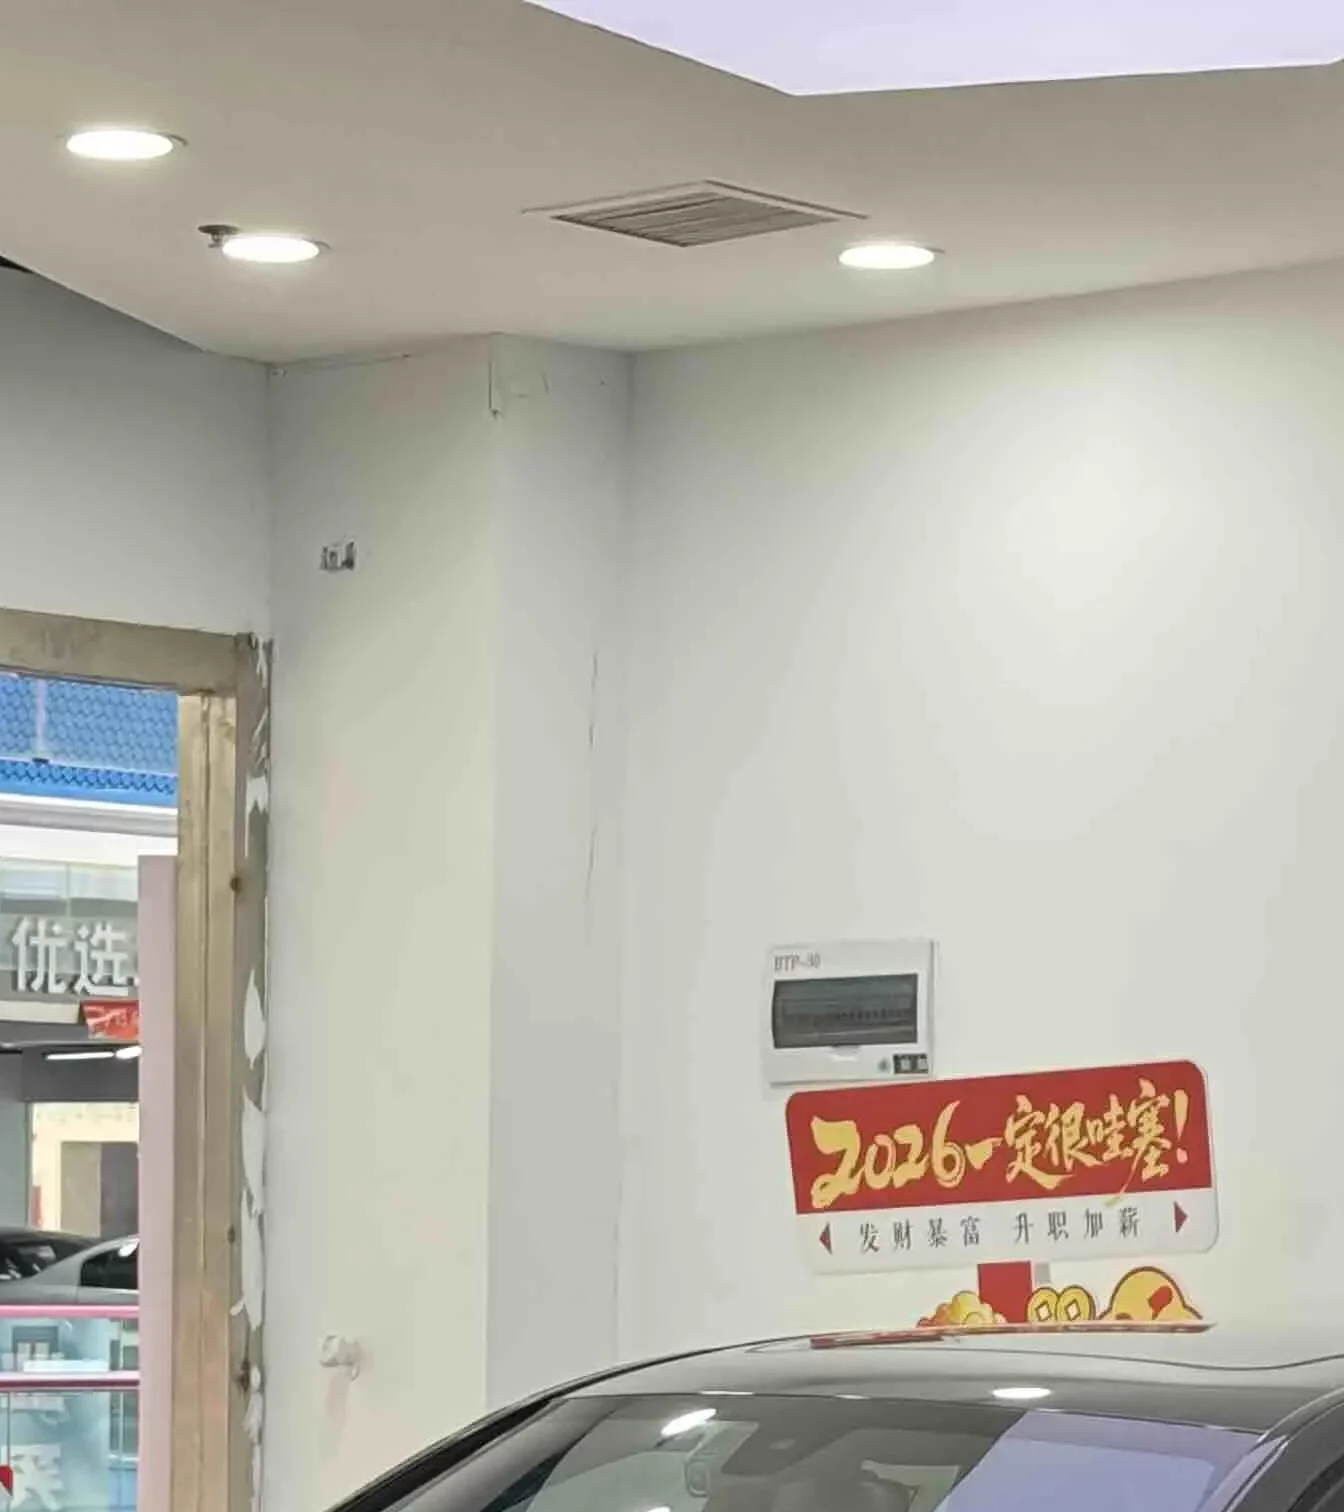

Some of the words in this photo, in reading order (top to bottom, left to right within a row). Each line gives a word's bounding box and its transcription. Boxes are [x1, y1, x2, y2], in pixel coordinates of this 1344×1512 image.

[12, 915, 139, 996] 优选
[859, 1215, 982, 1256] 发财暴富
[1014, 1206, 1141, 1246] 升职加薪
